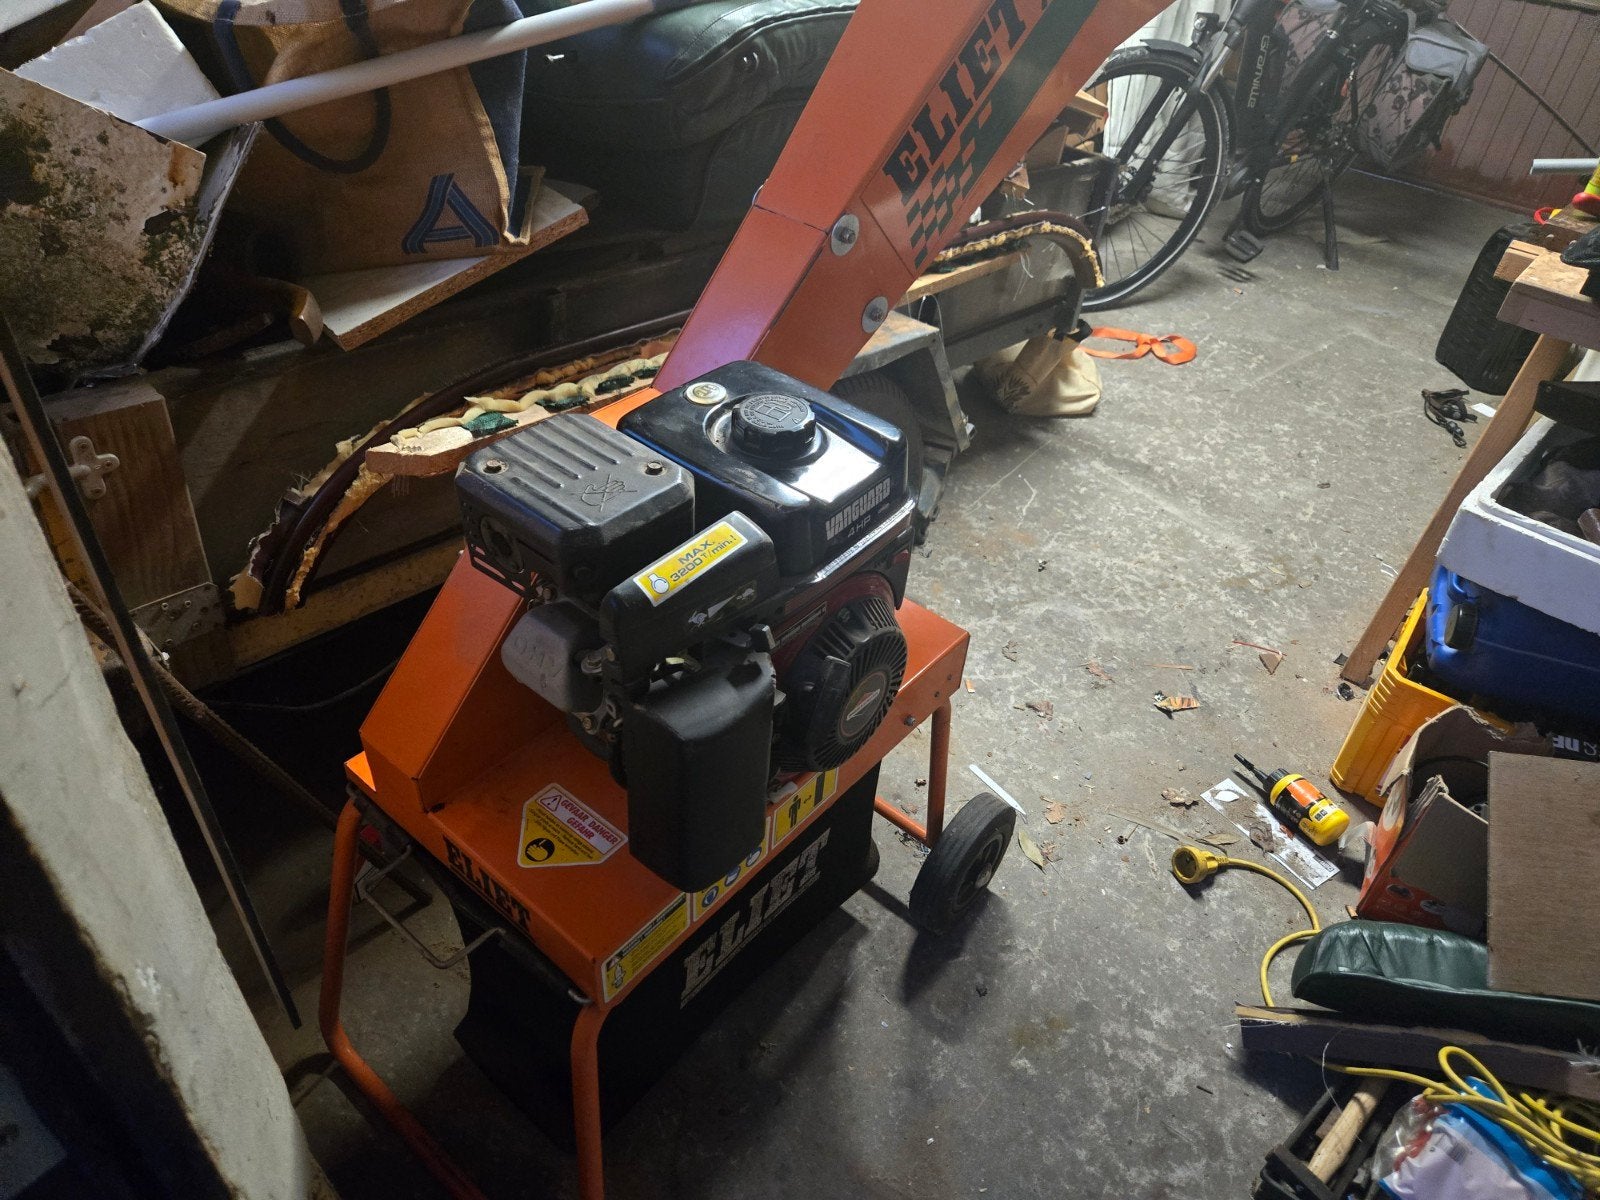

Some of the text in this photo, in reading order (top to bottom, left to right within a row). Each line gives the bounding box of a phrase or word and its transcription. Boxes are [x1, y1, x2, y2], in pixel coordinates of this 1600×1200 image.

[882, 0, 1027, 206] ELIET
[824, 477, 891, 541] VANGUARD
[560, 799, 589, 822] GEVAAR
[588, 820, 620, 846] DANGER
[566, 817, 595, 840] GEFAHR
[442, 832, 533, 933] ELIET
[680, 827, 831, 1002] ELIET
